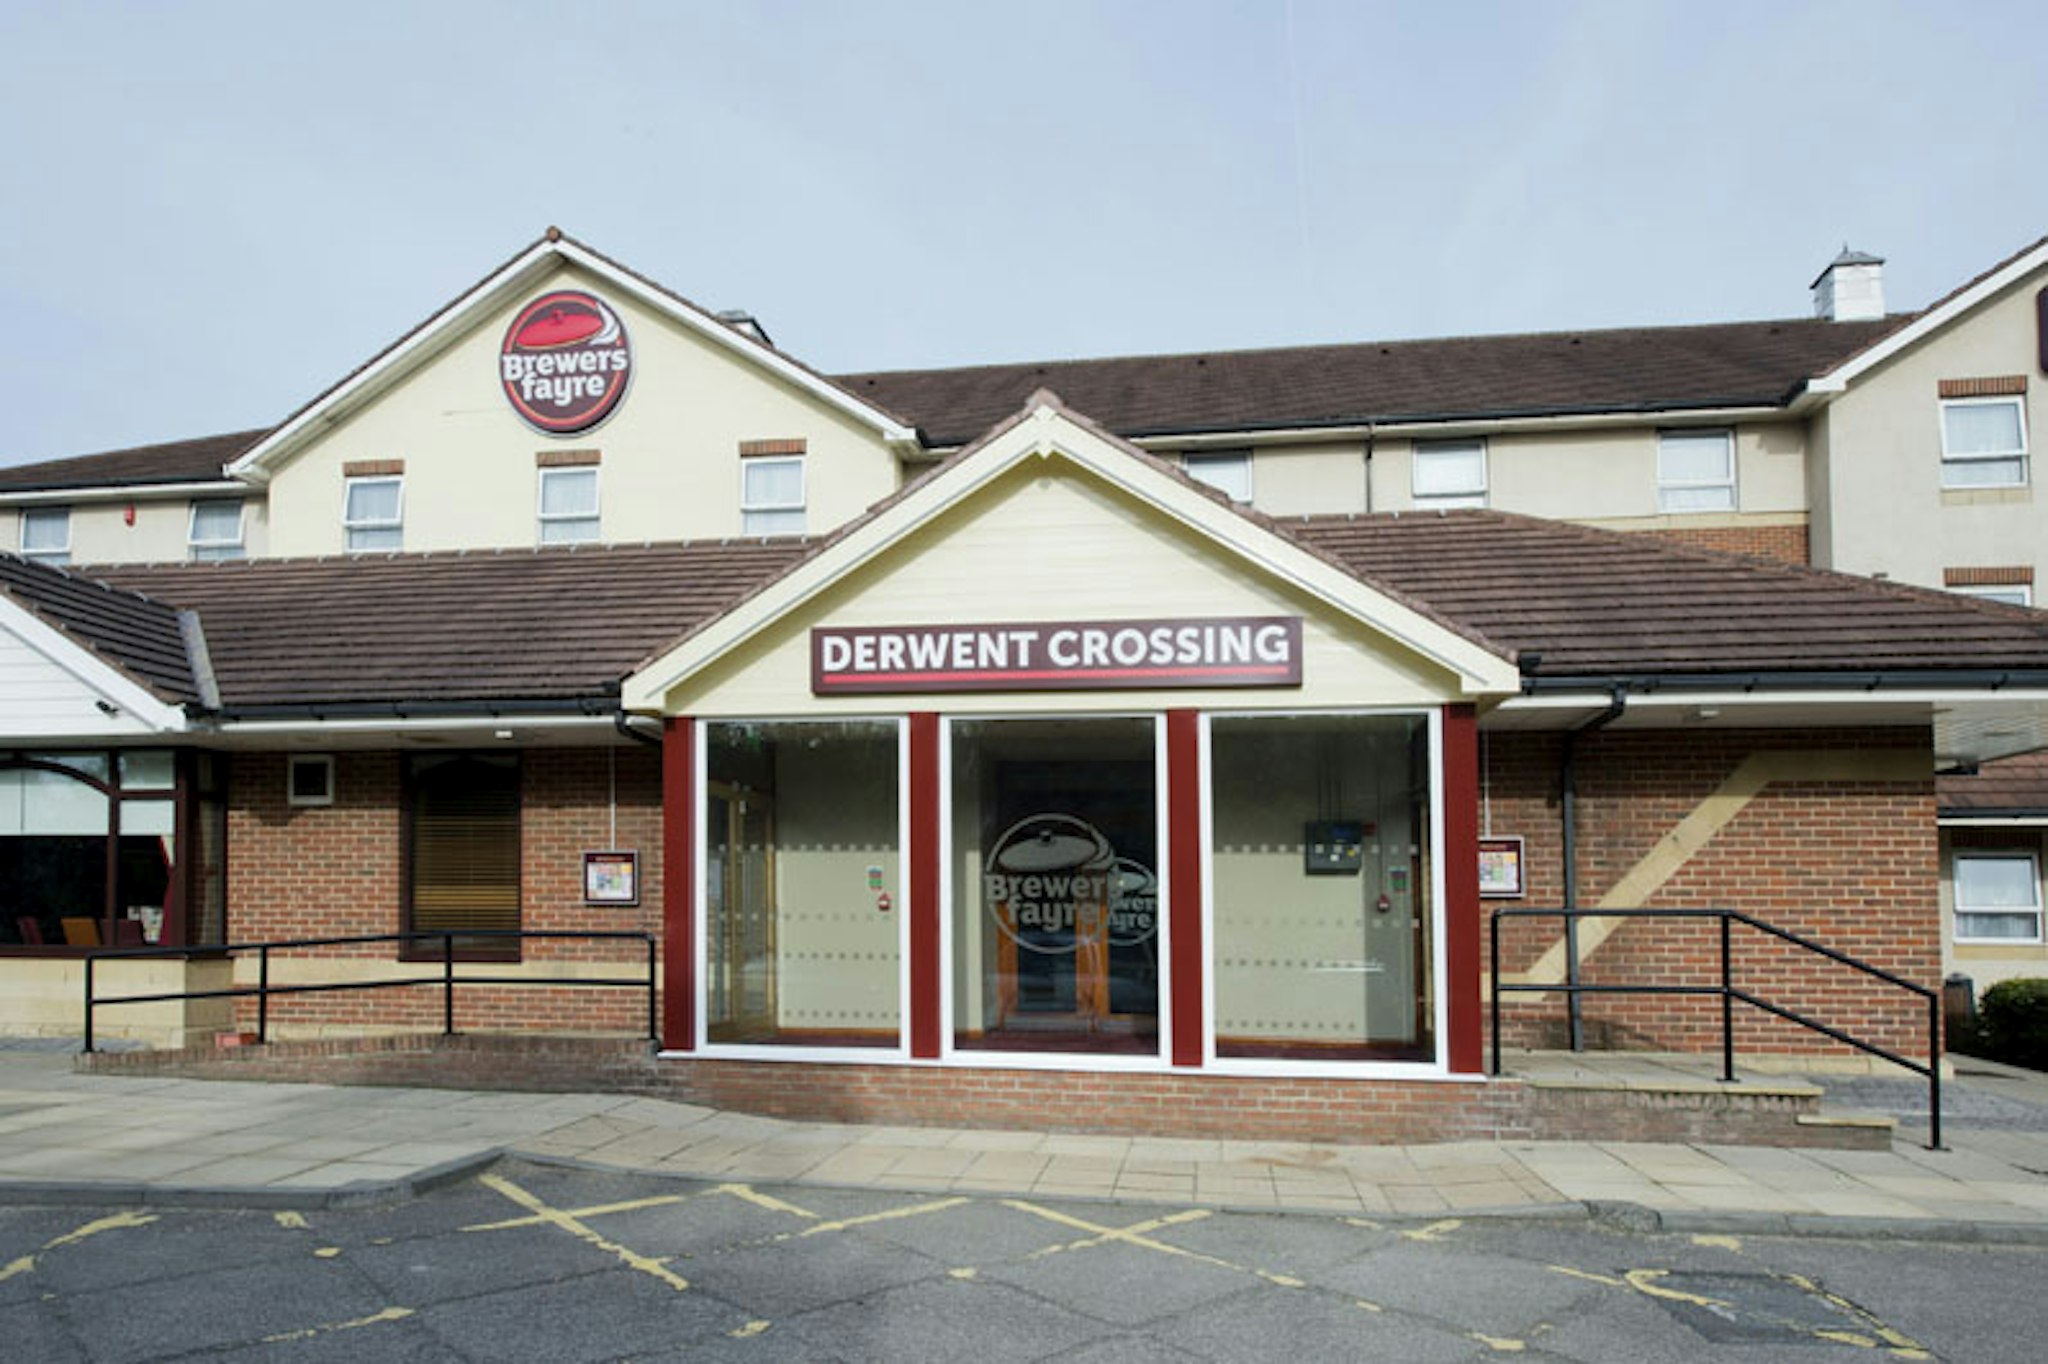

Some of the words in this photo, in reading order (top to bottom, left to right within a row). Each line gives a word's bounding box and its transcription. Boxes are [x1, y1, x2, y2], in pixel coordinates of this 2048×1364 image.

[502, 349, 627, 380] Brewers
[521, 371, 605, 406] fayre
[822, 631, 1039, 672] DERWENT
[1048, 625, 1289, 667] CROSSING
